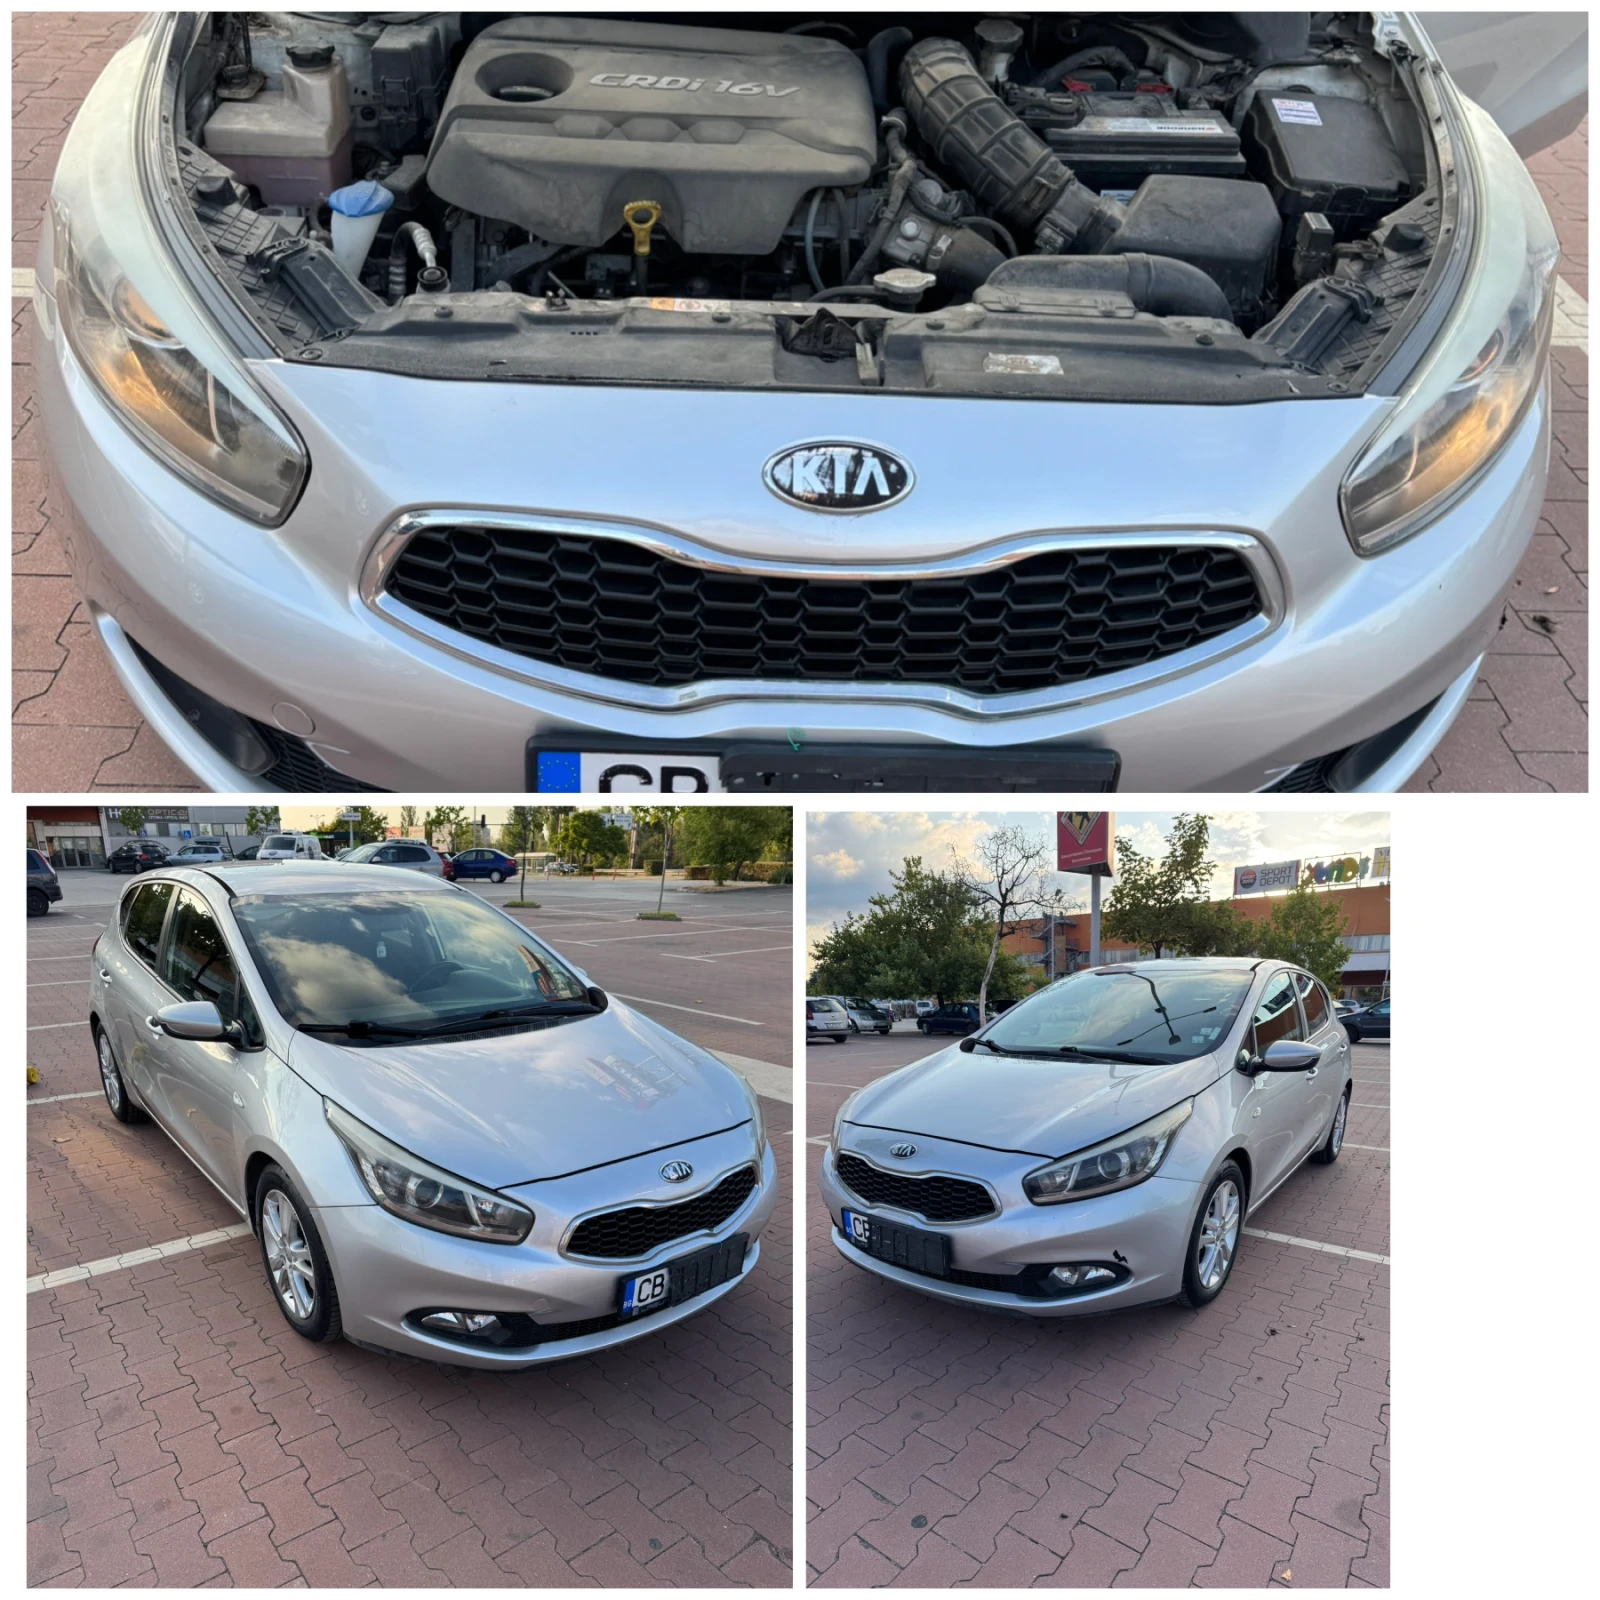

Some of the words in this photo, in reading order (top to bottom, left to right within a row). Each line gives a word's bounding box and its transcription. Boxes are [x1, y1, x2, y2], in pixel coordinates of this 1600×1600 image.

[590, 73, 706, 91] CRDi
[714, 79, 801, 97] 16V
[792, 454, 892, 497] KIA
[147, 808, 177, 816] OPTIC
[1260, 866, 1294, 877] SPORT
[1260, 875, 1292, 886] DEPOT
[637, 1272, 665, 1304] CB
